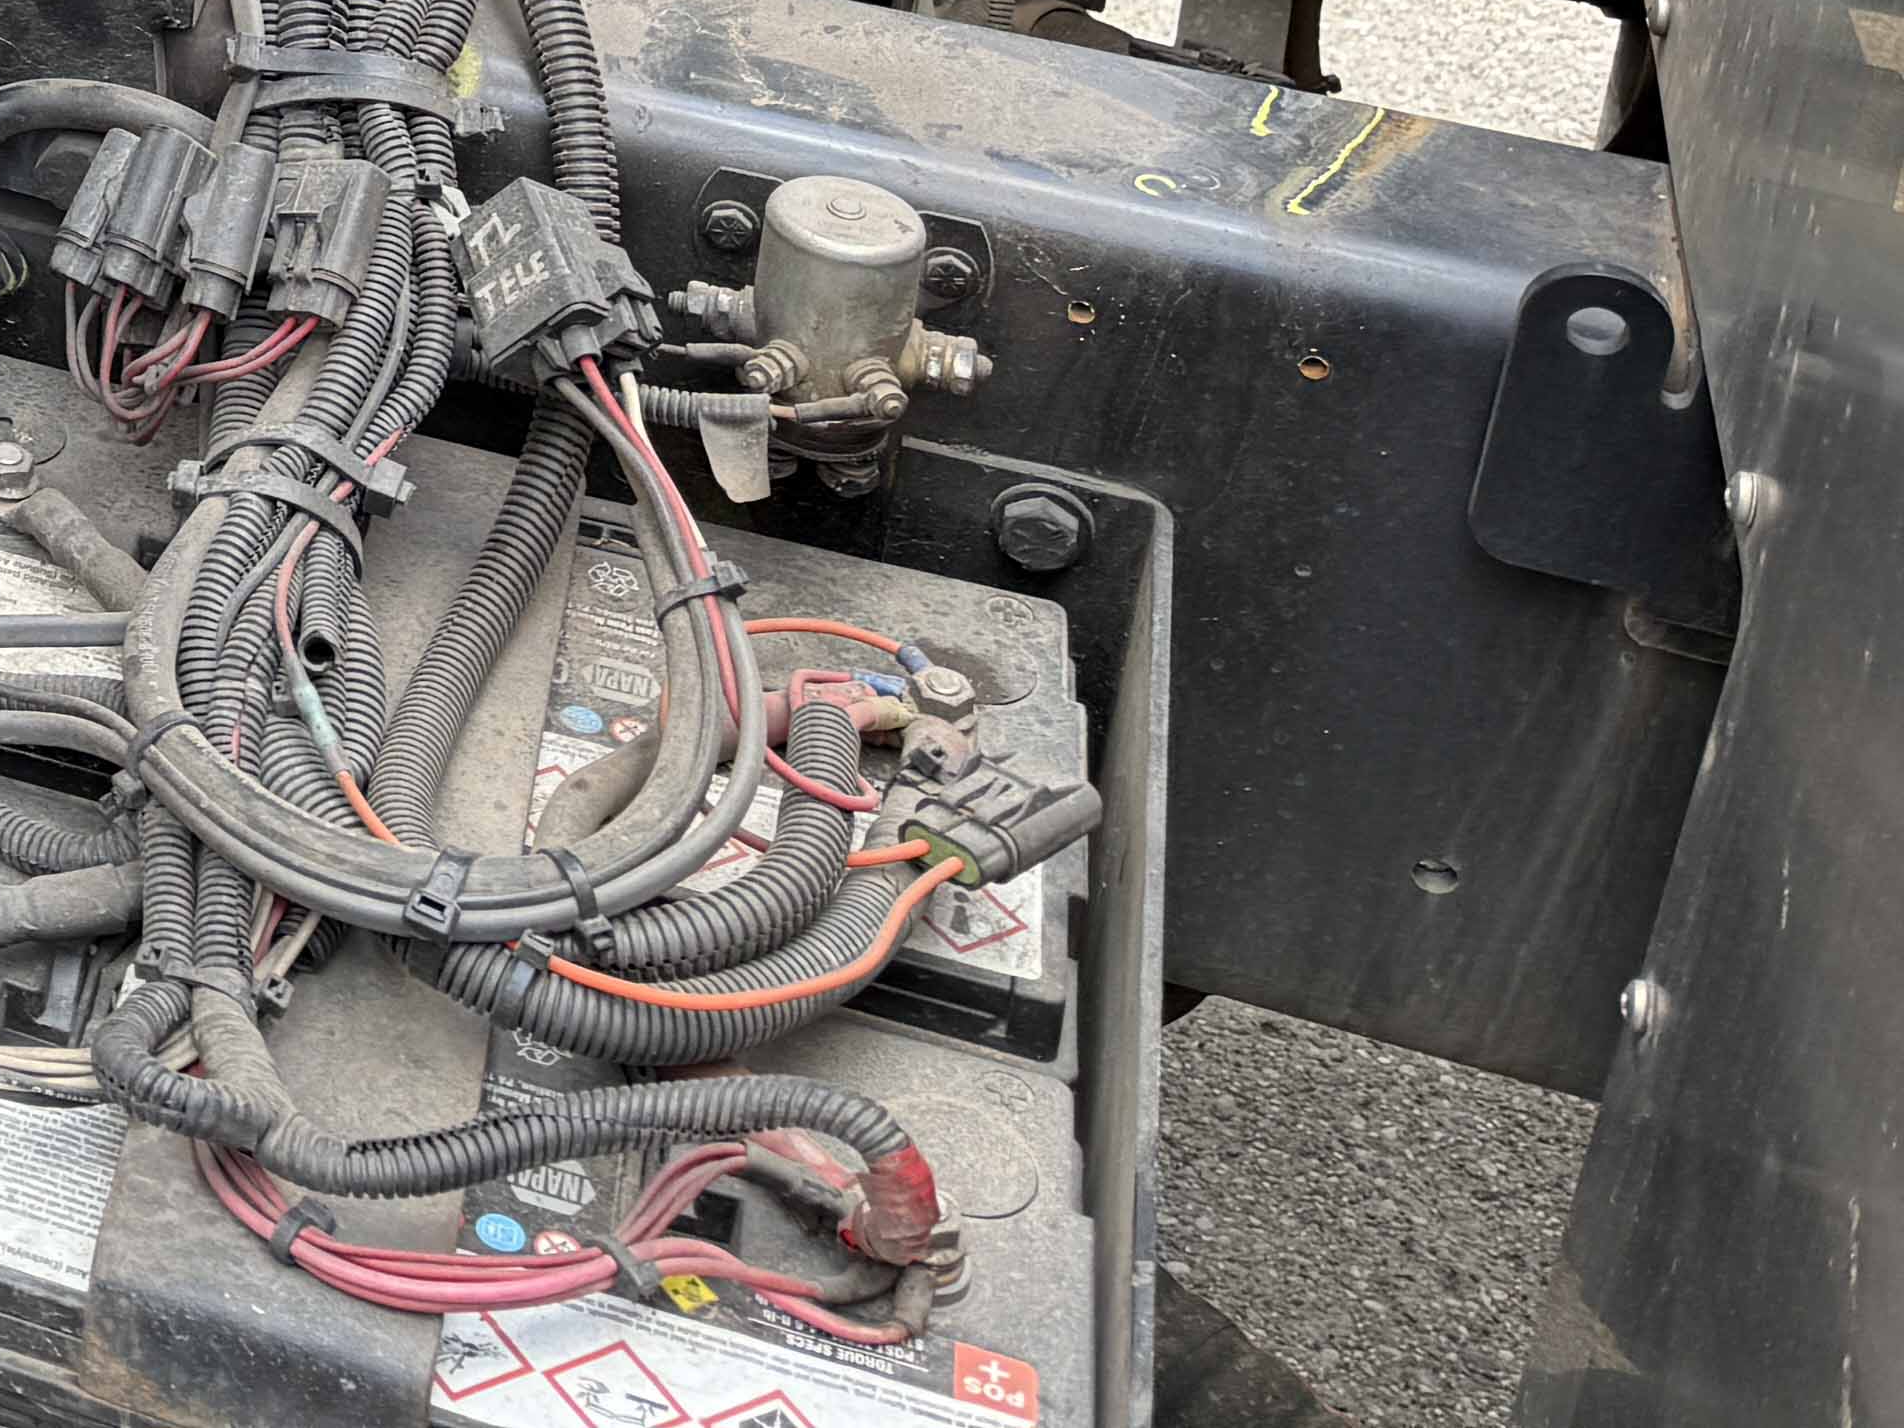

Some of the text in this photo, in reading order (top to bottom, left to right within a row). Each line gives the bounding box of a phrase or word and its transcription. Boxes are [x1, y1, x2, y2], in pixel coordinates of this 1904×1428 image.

[592, 663, 648, 697] NAPA
[785, 1333, 895, 1374] TORQUE SPECS
[962, 1374, 1025, 1409] POS
